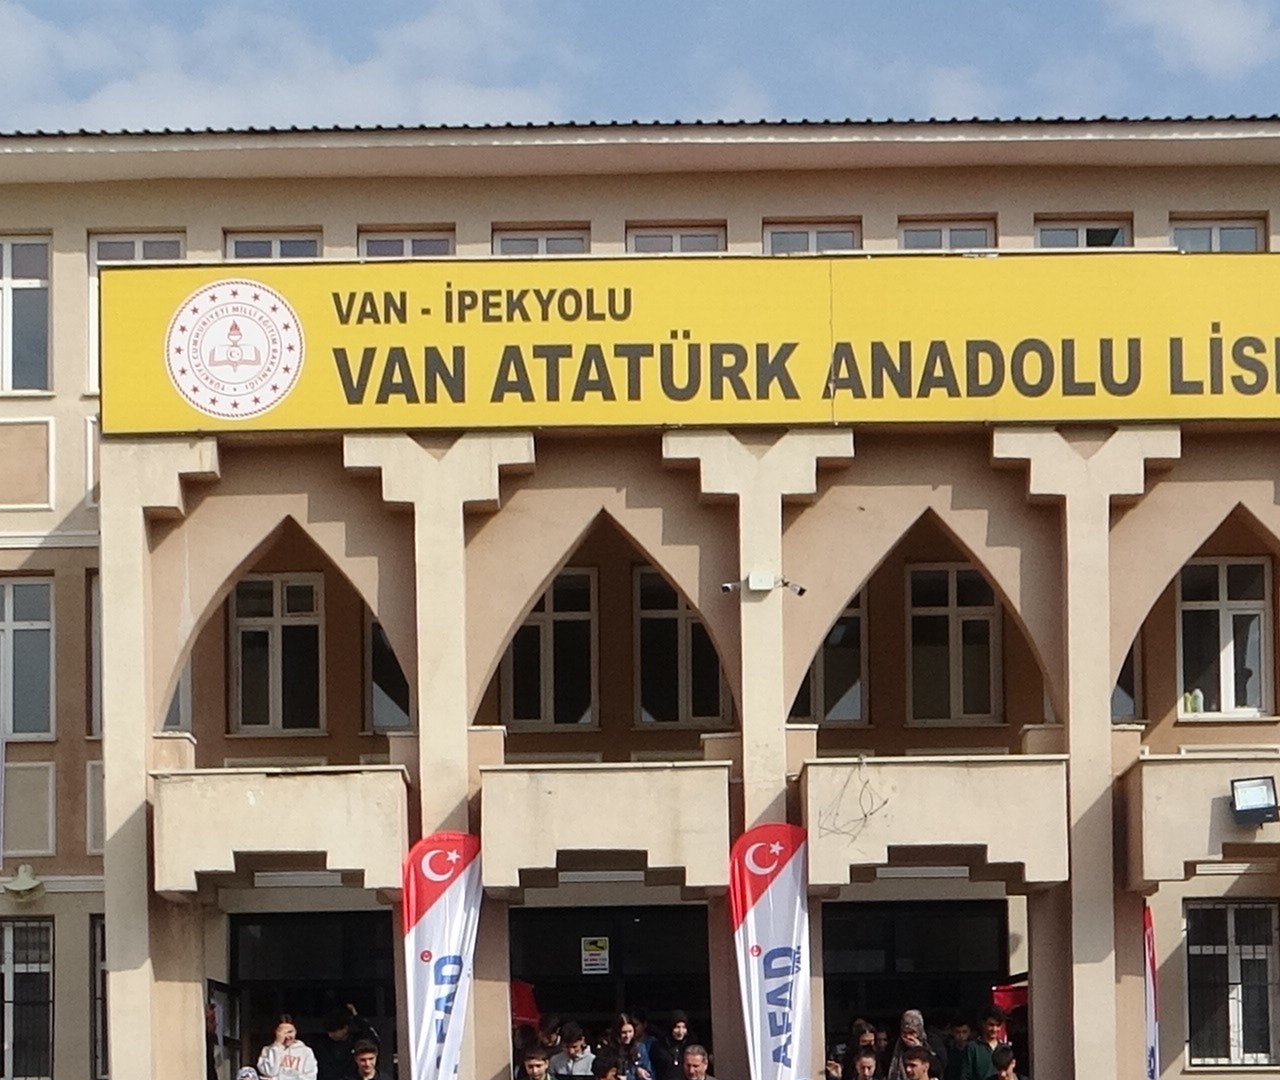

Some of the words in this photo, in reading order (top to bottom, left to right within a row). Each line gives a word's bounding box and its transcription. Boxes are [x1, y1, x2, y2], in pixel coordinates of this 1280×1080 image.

[331, 291, 408, 325] VAN
[445, 281, 633, 324] İPEKYOLU
[332, 345, 466, 405] VAN
[490, 329, 801, 403] ATATÜRK
[821, 337, 1142, 400] ANADOLU
[763, 946, 796, 1069] AFAD
